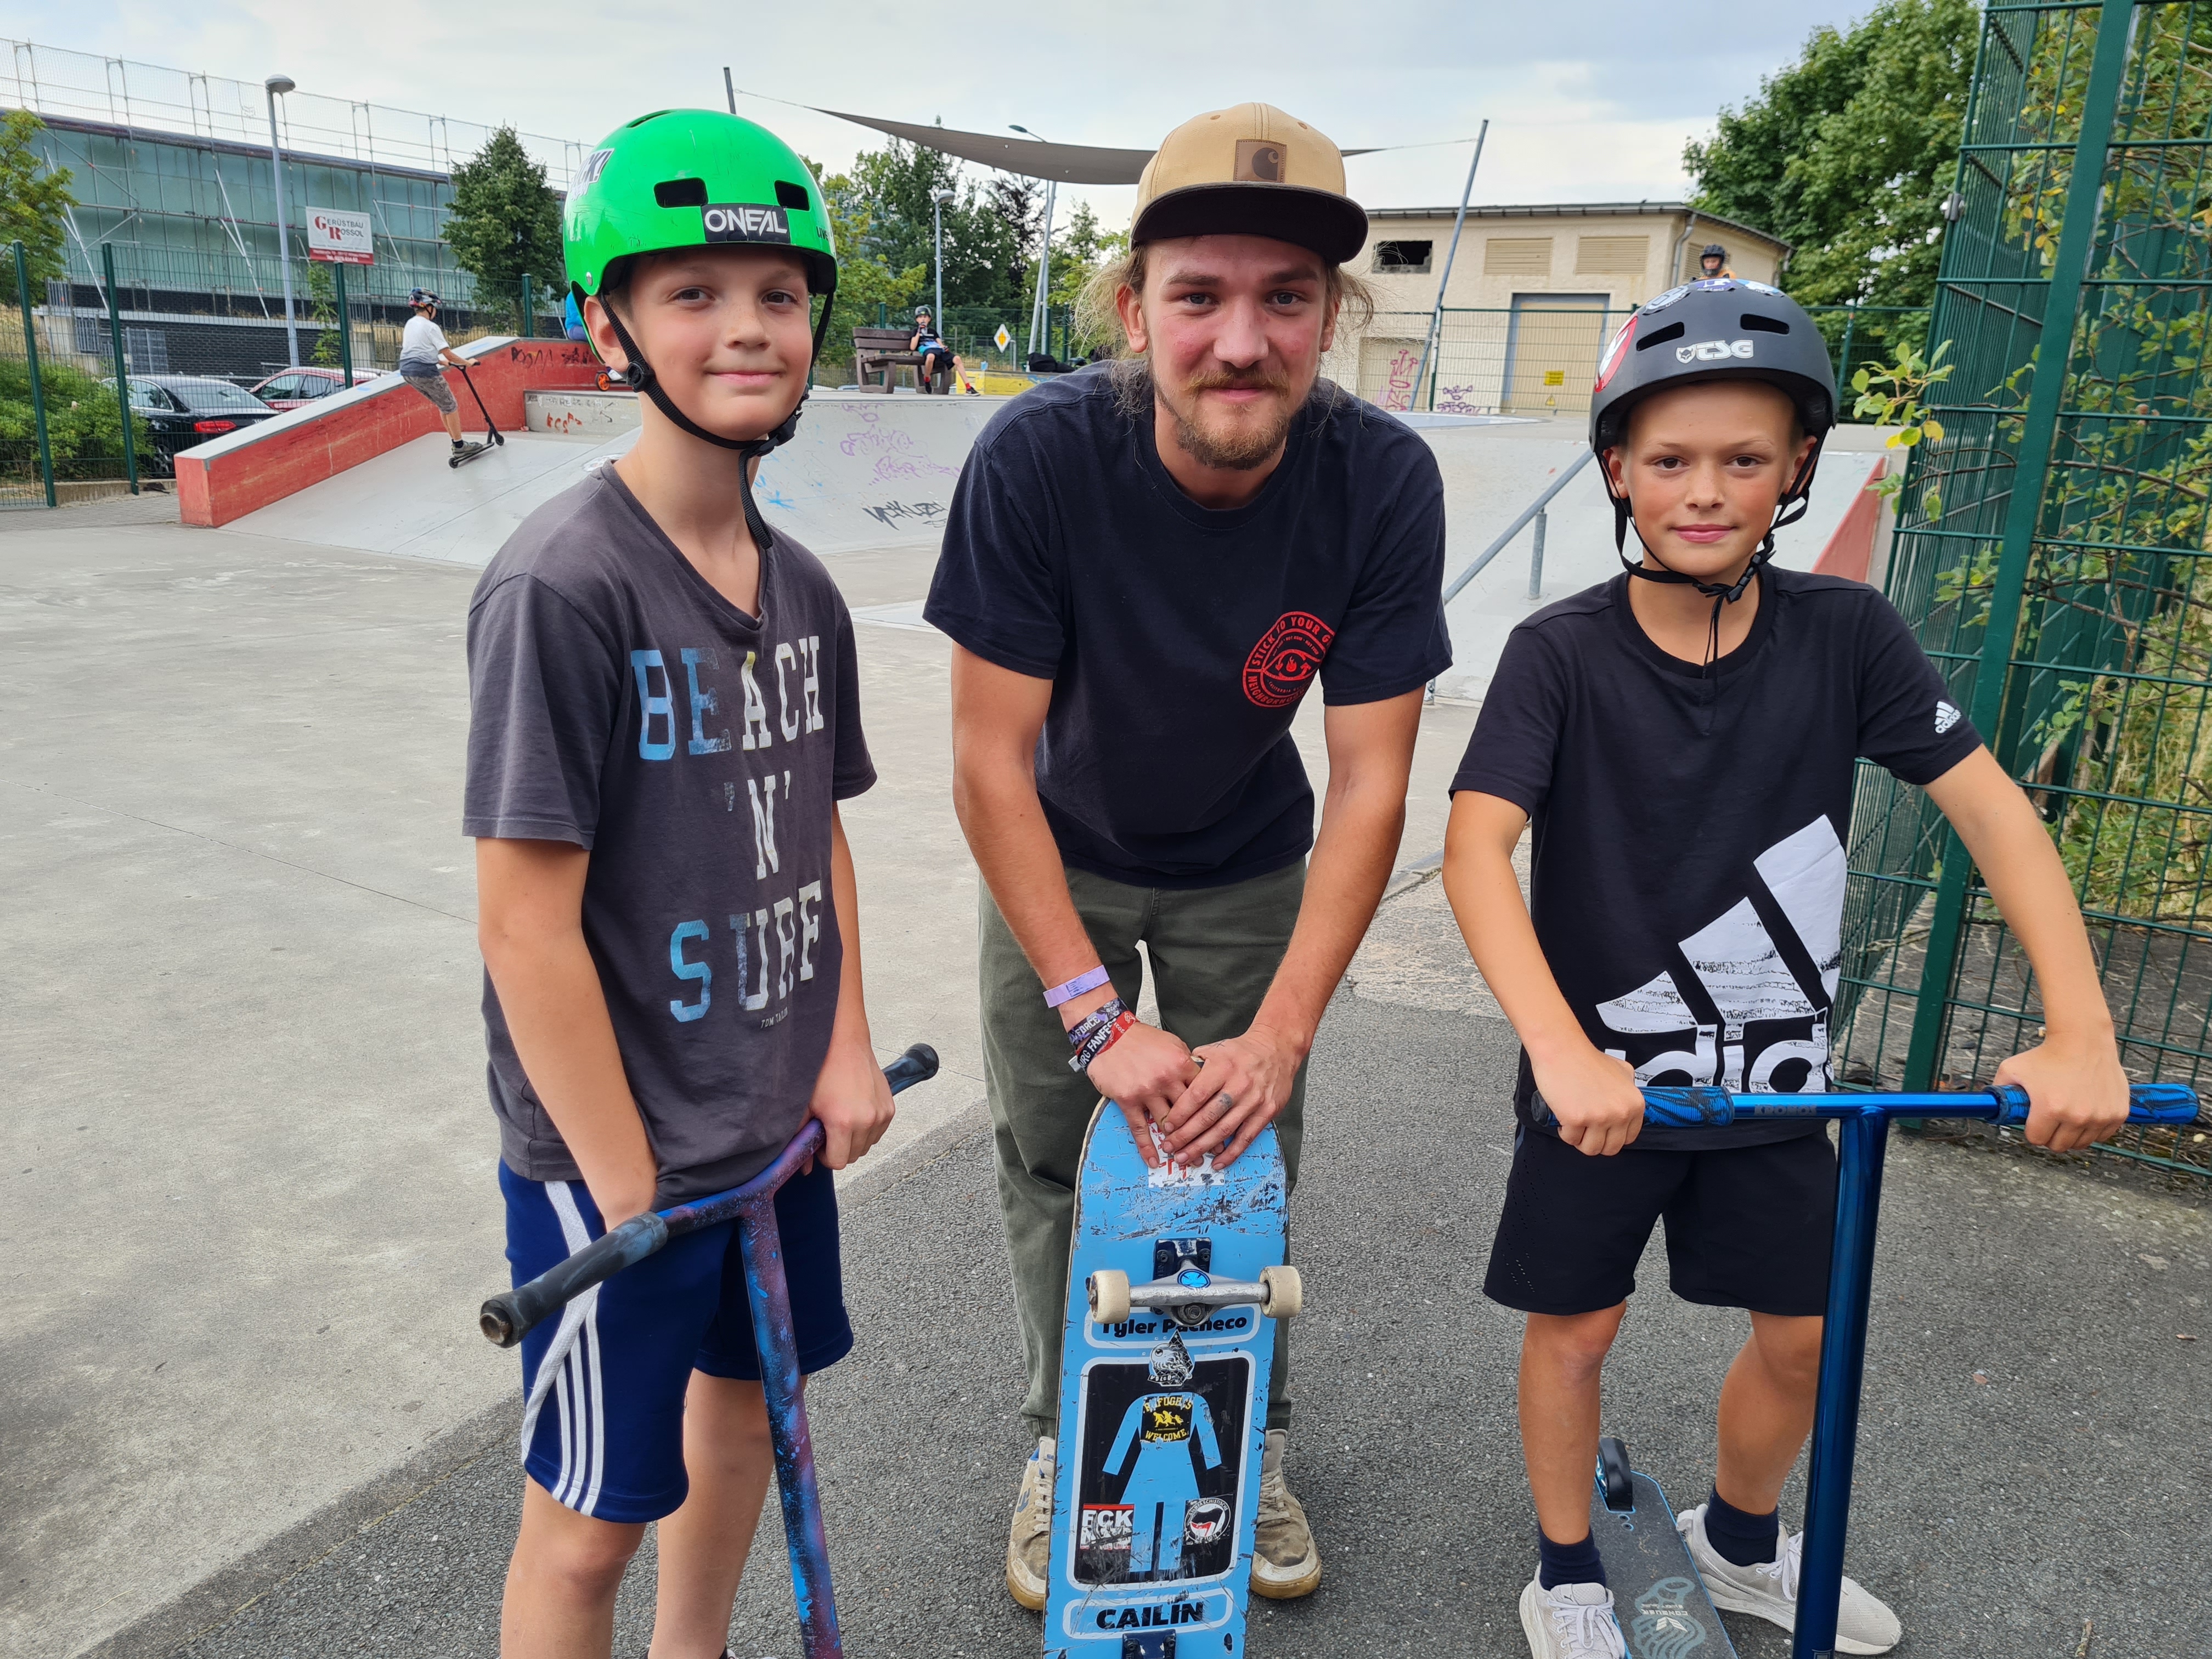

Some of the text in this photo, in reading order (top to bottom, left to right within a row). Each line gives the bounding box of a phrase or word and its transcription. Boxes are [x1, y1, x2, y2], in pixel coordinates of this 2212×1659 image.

[329, 226, 364, 241] ROSSOL
[1251, 634, 1276, 667] STICK
[1276, 620, 1286, 634] TO
[1291, 617, 1321, 635] YOUR
[630, 635, 824, 760] BEACH
[670, 880, 822, 1023] SURF
[1082, 1510, 1133, 1527] FCK
